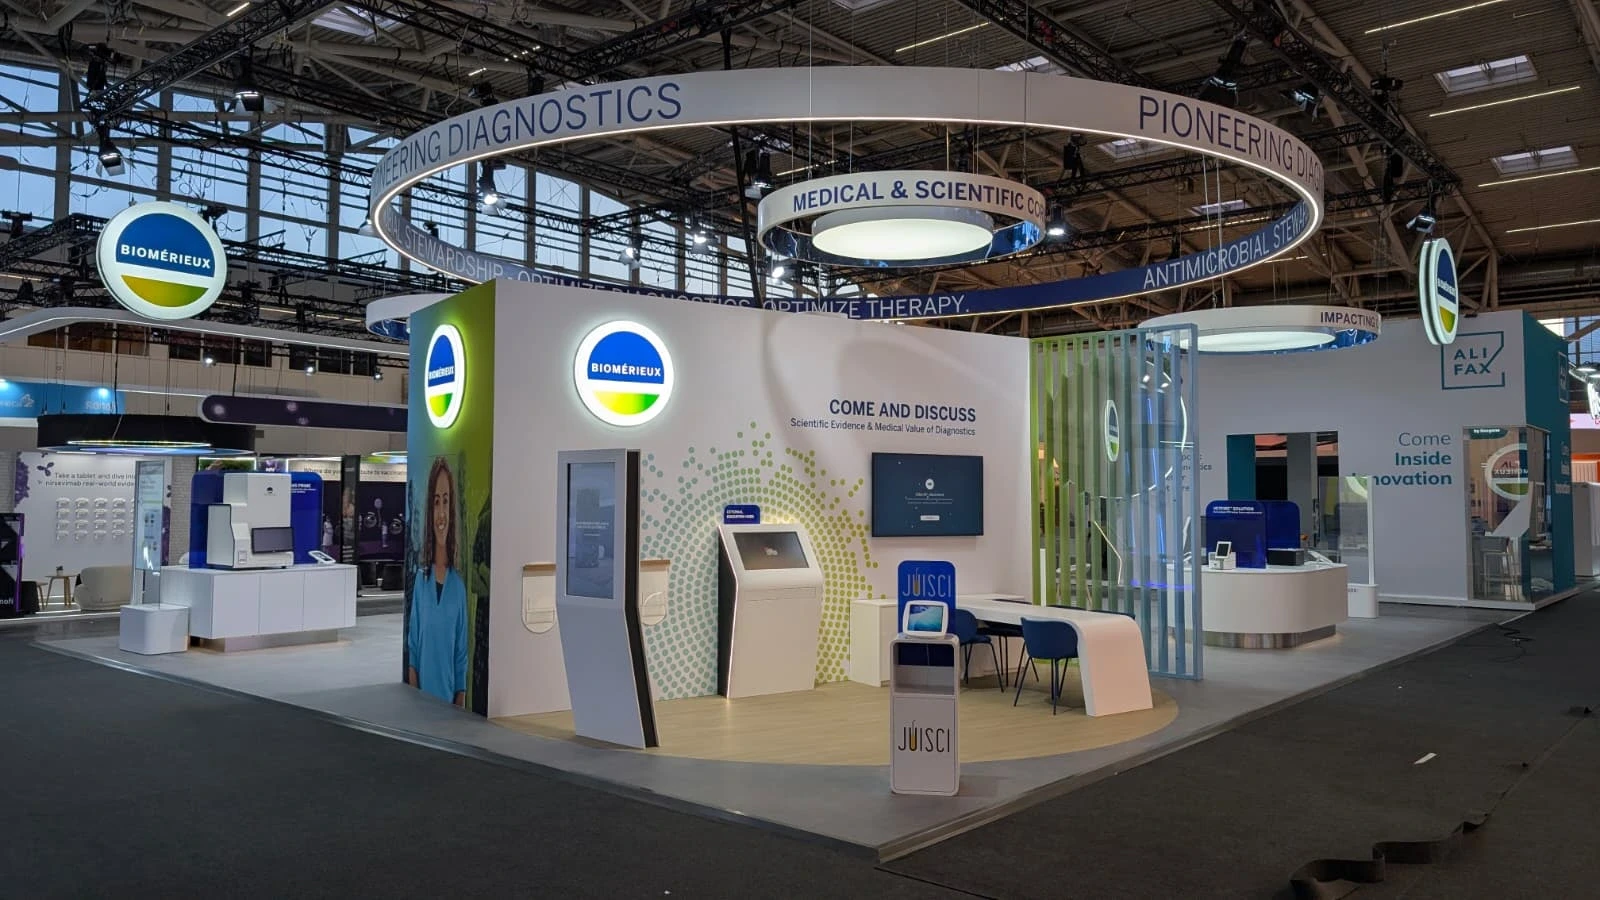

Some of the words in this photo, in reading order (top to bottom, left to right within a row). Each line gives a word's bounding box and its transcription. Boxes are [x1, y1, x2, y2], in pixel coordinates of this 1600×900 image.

[376, 130, 441, 190] NEERING
[449, 82, 681, 155] DIAGNOSTICS
[1139, 95, 1293, 172] PIONEERING
[1298, 146, 1323, 191] DIAG
[793, 184, 884, 212] MEDICAL
[890, 180, 909, 199] &
[915, 180, 1024, 210] SCIENTIFIC
[121, 244, 211, 269] BIOMÉRIEUX
[405, 226, 503, 281] STEWARDSHIP
[1143, 233, 1269, 289] ANTIMICROBIAL
[866, 295, 969, 317] THERAPY.
[1321, 312, 1375, 327] IMPACTING
[1454, 347, 1487, 360] ALI
[591, 362, 661, 377] BIOMÉRIEUX
[1454, 363, 1490, 375] FAX
[830, 399, 875, 416] COME
[879, 402, 910, 418] AND
[915, 405, 976, 422] DISCUSS
[791, 418, 829, 428] Scientific
[831, 420, 866, 431] Evidence
[867, 422, 873, 430] &
[875, 423, 903, 432] Medical
[905, 424, 925, 433] Value
[926, 425, 934, 433] of
[935, 426, 976, 436] Diagnostics
[1398, 432, 1451, 446] Come
[1395, 451, 1451, 466] Inside
